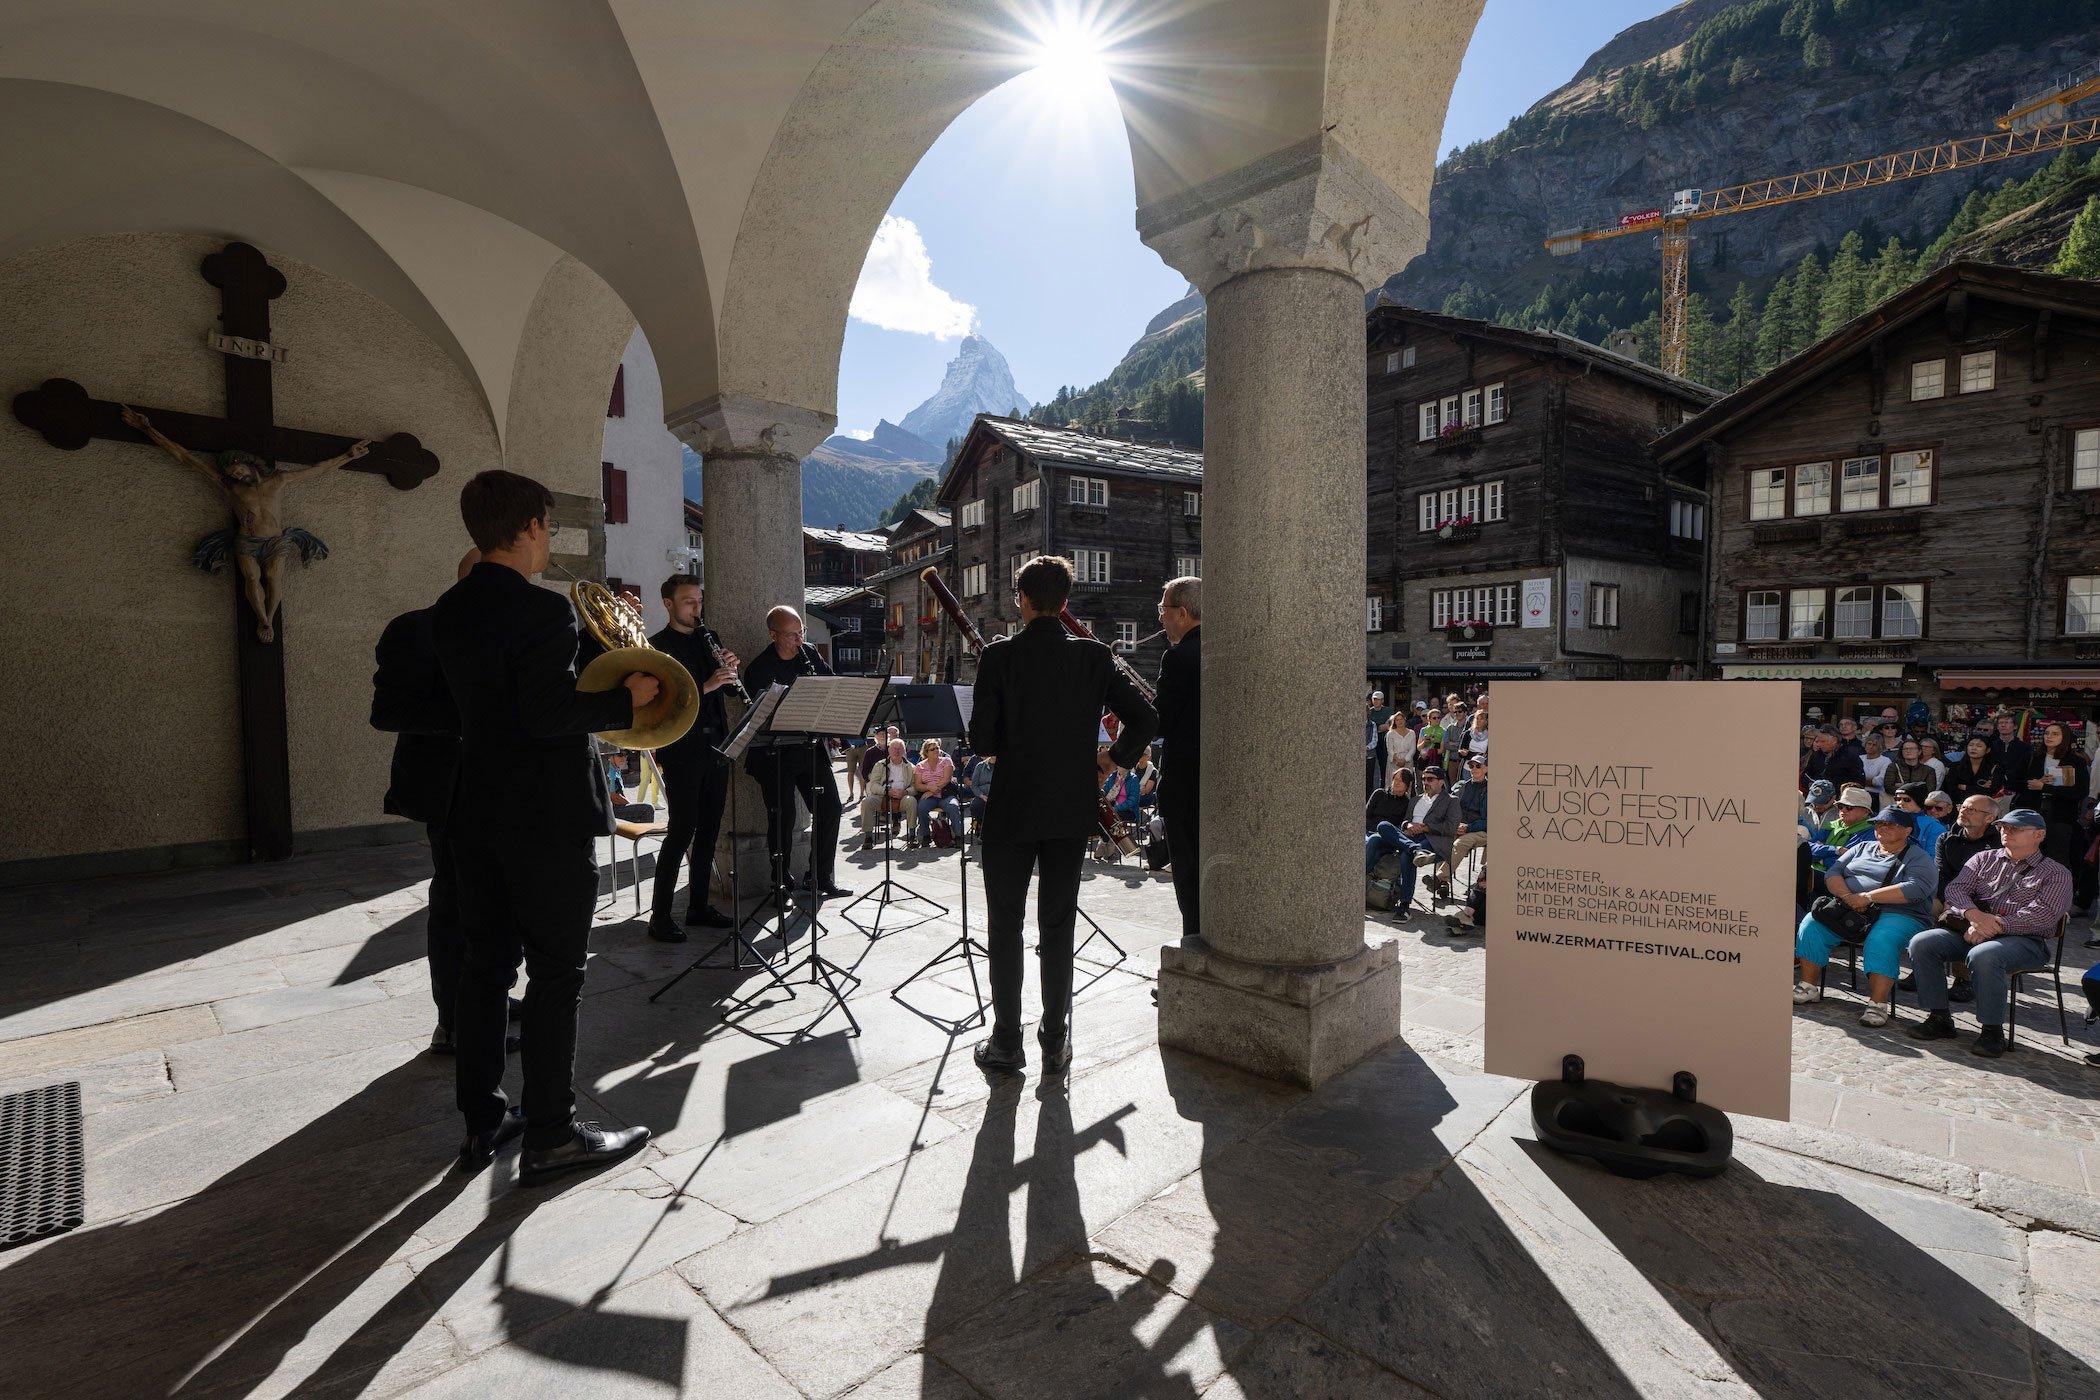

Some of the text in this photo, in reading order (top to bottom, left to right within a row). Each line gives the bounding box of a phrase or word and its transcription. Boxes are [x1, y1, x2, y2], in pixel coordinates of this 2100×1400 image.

[1632, 211, 1660, 221] VOLKEN
[1456, 648, 1486, 659] puralpina
[1747, 669, 1873, 677] GELATO ITALIANO
[1517, 762, 1653, 790] ZERMATT
[1516, 789, 1761, 825] MUSIC FESTIVAL
[1516, 815, 1695, 848] & ACADEMY
[1516, 866, 1605, 884] ORCHESTER,
[1516, 880, 1717, 906] KAMMERMUSIK & AKADEMIE
[1516, 892, 1749, 923] MIT DEM SCHAROUN ENSEMBLE
[1516, 904, 1759, 938] DER BERLINER PHILHARMONIKER
[1515, 930, 1742, 964] WWW.ZERMATTFESTIVAL.COM
